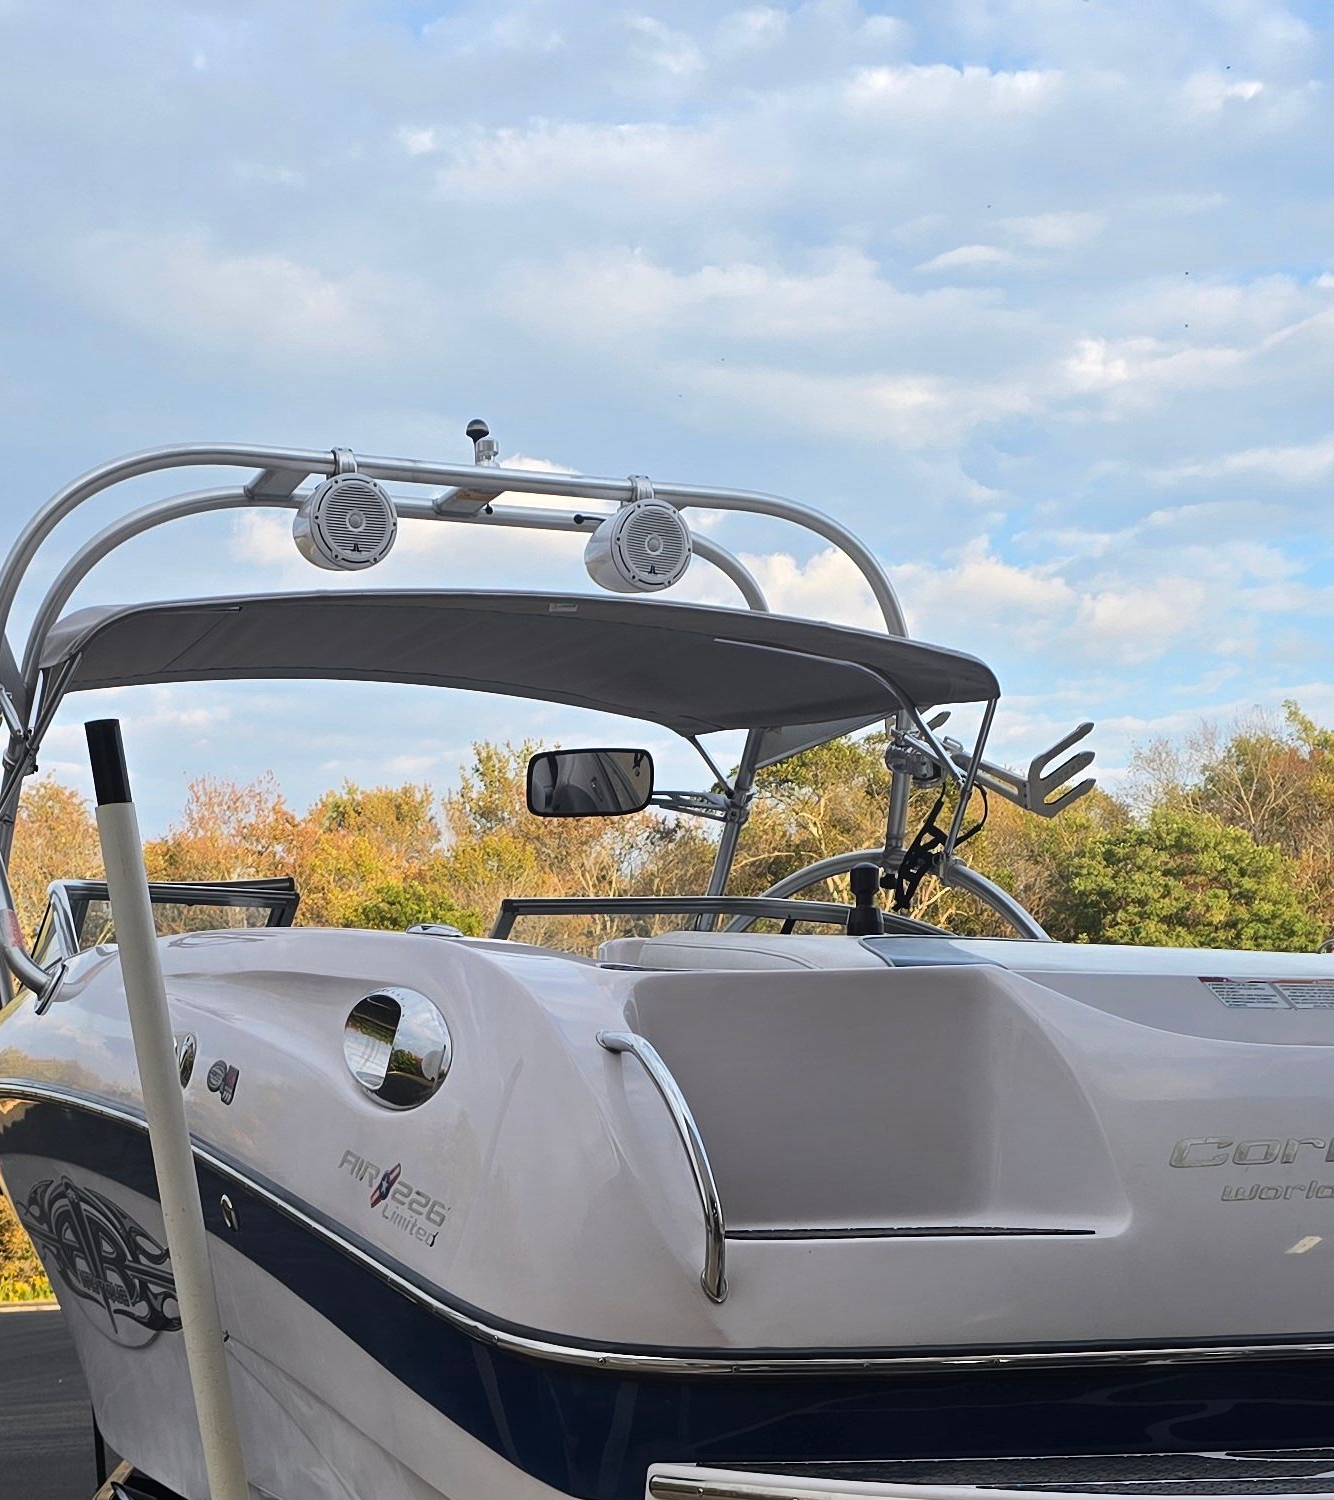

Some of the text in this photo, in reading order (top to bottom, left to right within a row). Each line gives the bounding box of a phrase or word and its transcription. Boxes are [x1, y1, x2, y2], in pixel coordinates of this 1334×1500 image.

[338, 1150, 447, 1228] AIR 226
[381, 1203, 439, 1247] Limited
